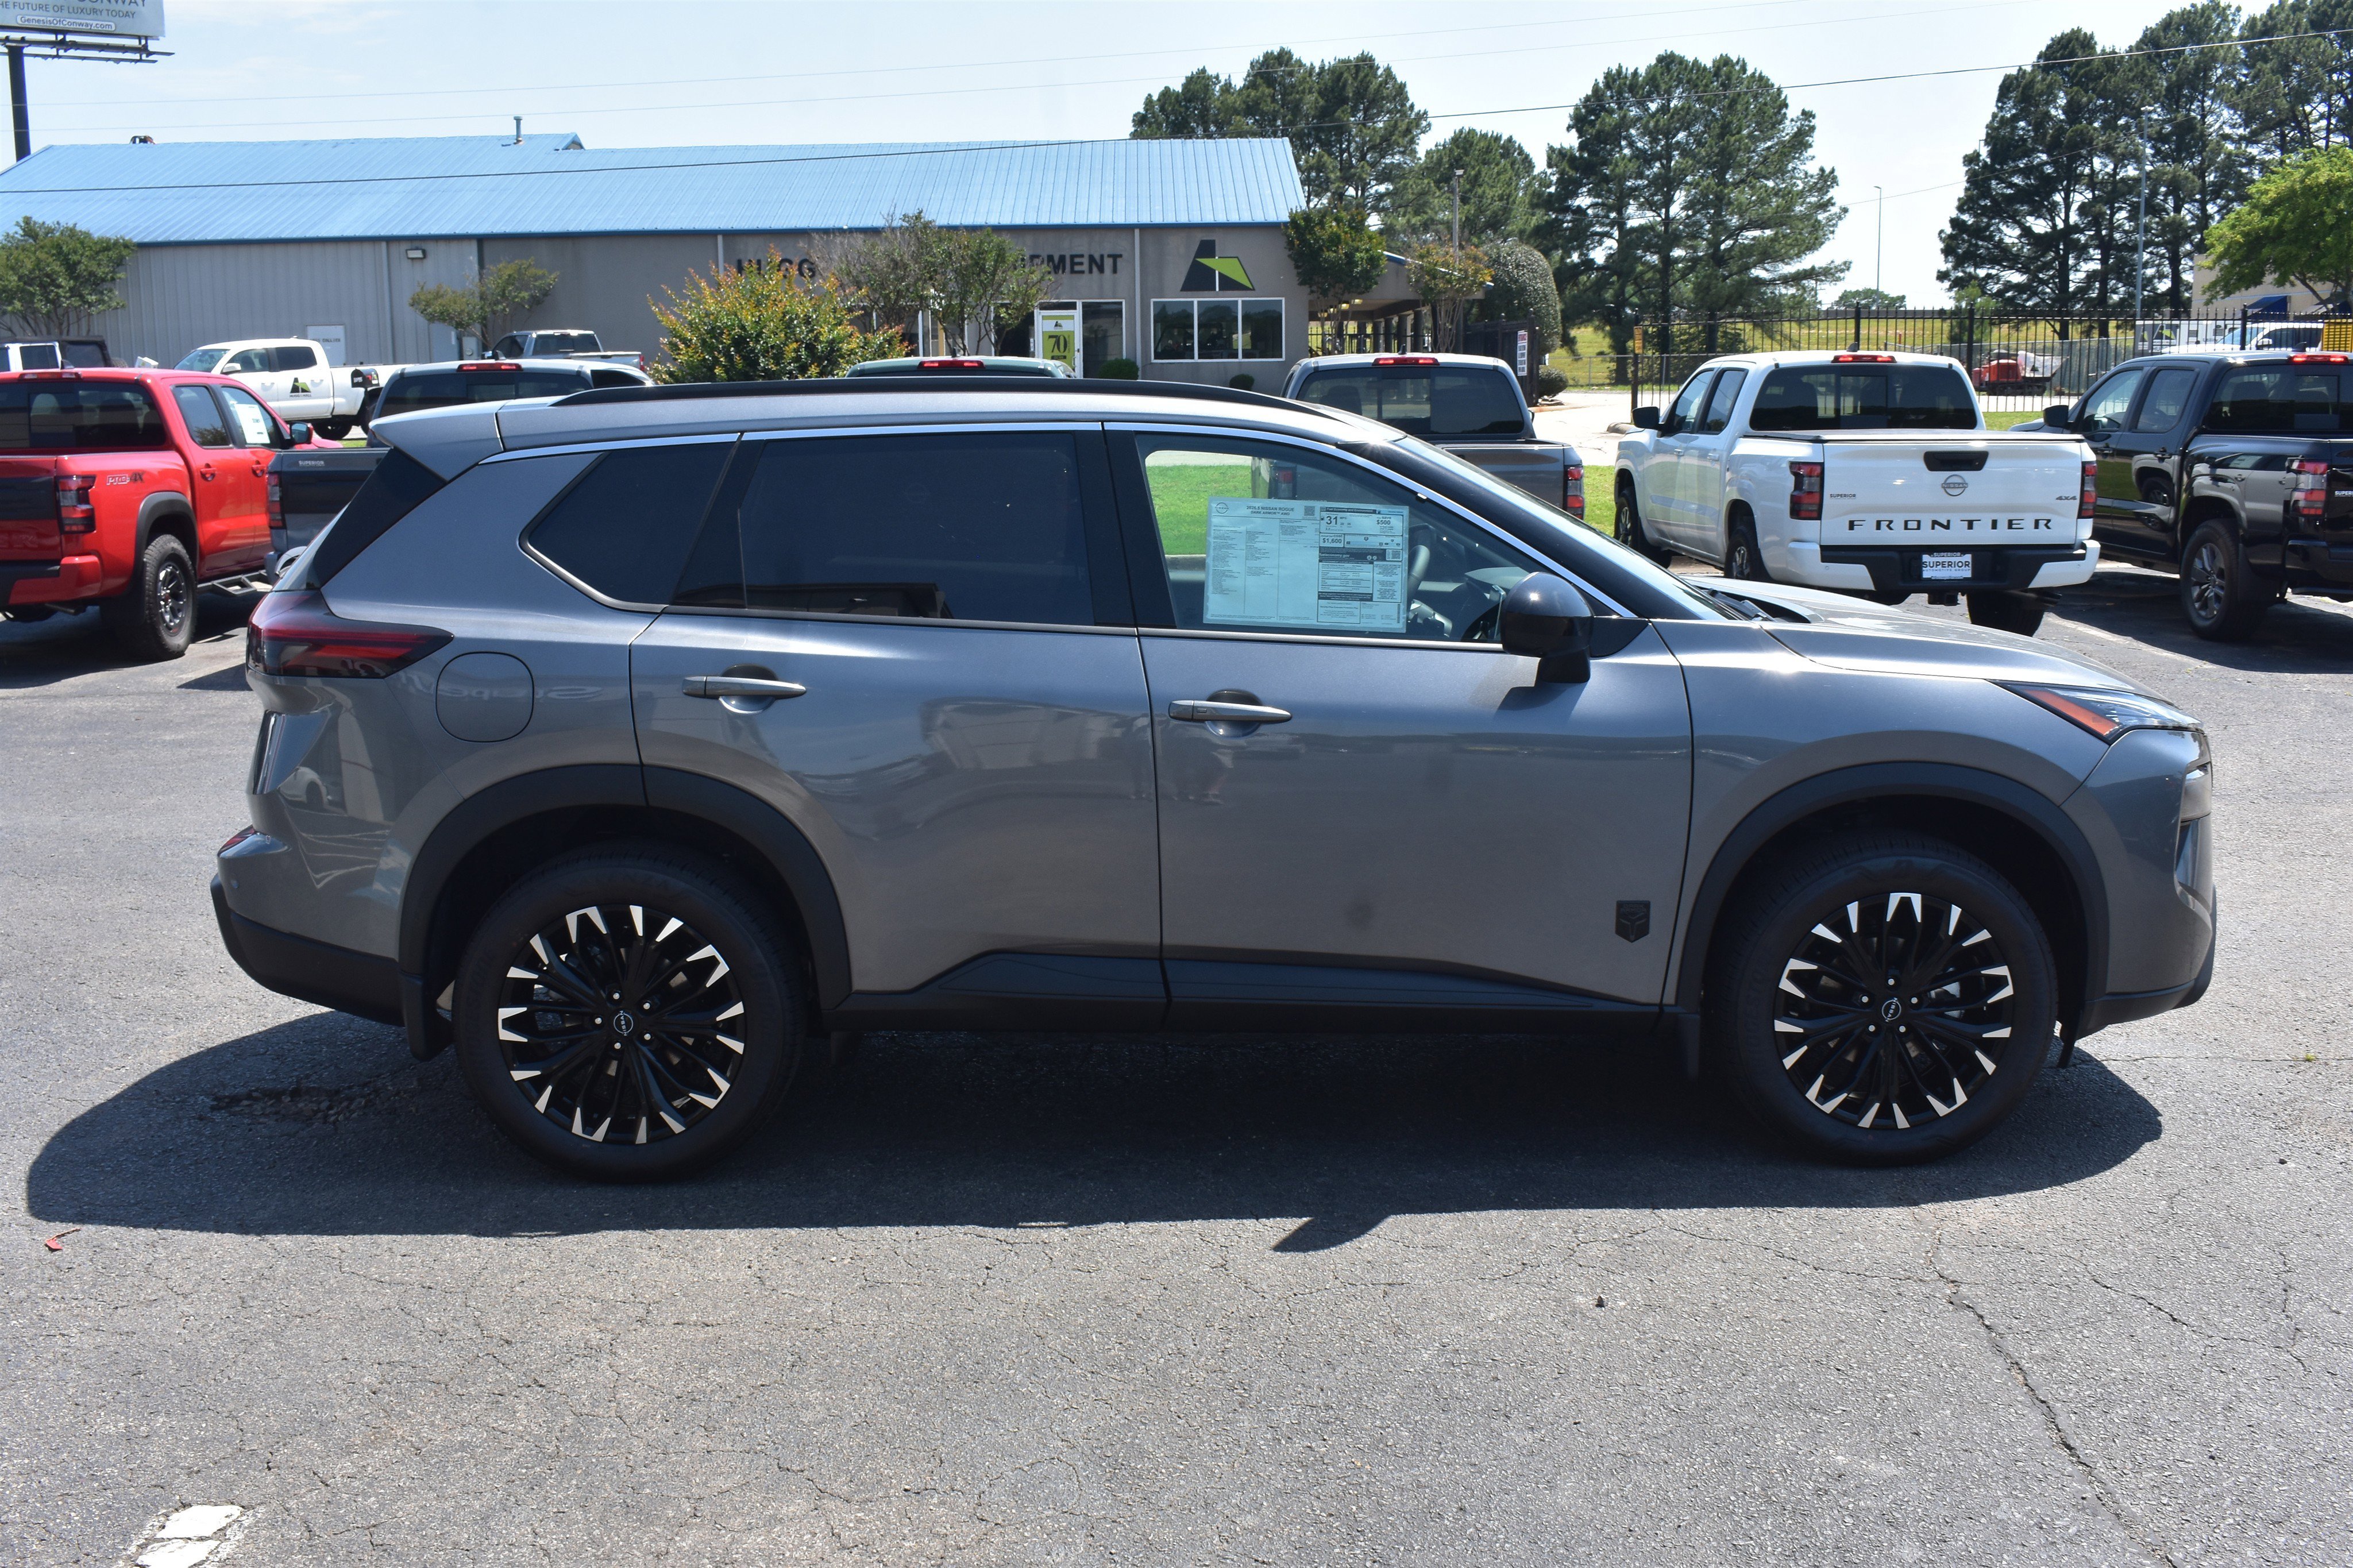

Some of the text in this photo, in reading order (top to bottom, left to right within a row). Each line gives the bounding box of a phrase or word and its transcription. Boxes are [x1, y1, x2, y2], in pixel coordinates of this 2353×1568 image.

[13, 2, 50, 11] FUTURE
[67, 6, 104, 16] LUXURY
[105, 9, 136, 18] TODAY
[20, 16, 113, 29] GenesisOfConway.com
[1047, 335, 1067, 353] 70
[1326, 516, 1337, 525] 31
[1848, 519, 2051, 531] FRONTIER
[1885, 997, 1898, 1022] NISSAN
[619, 1010, 628, 1036] NISSAN
